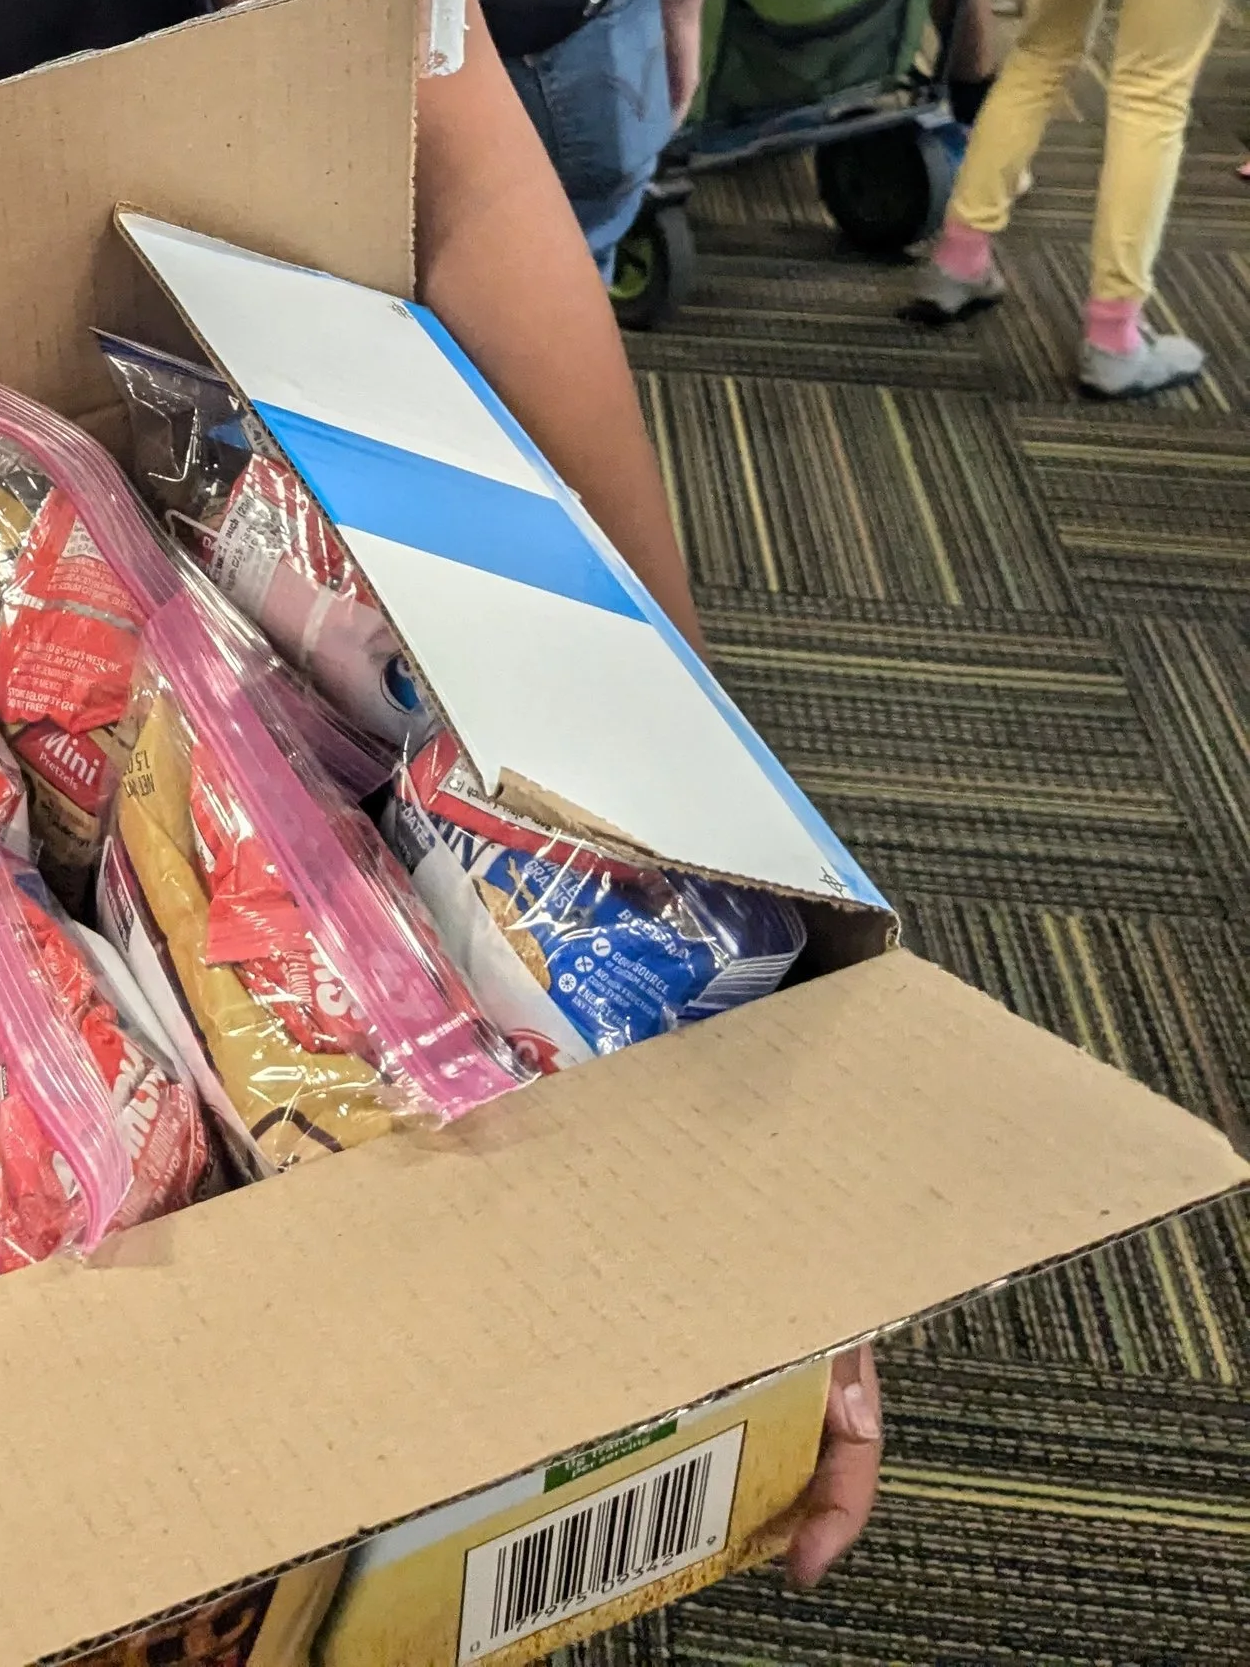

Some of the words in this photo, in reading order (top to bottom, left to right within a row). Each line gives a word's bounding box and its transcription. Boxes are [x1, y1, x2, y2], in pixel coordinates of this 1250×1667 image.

[39, 732, 100, 787] Mini
[39, 751, 79, 791] Pretzels
[594, 968, 609, 985] NO
[470, 1641, 481, 1653] 0
[515, 1590, 588, 1633] 77975
[601, 1553, 675, 1594] 09342
[706, 1535, 717, 1547] 9
